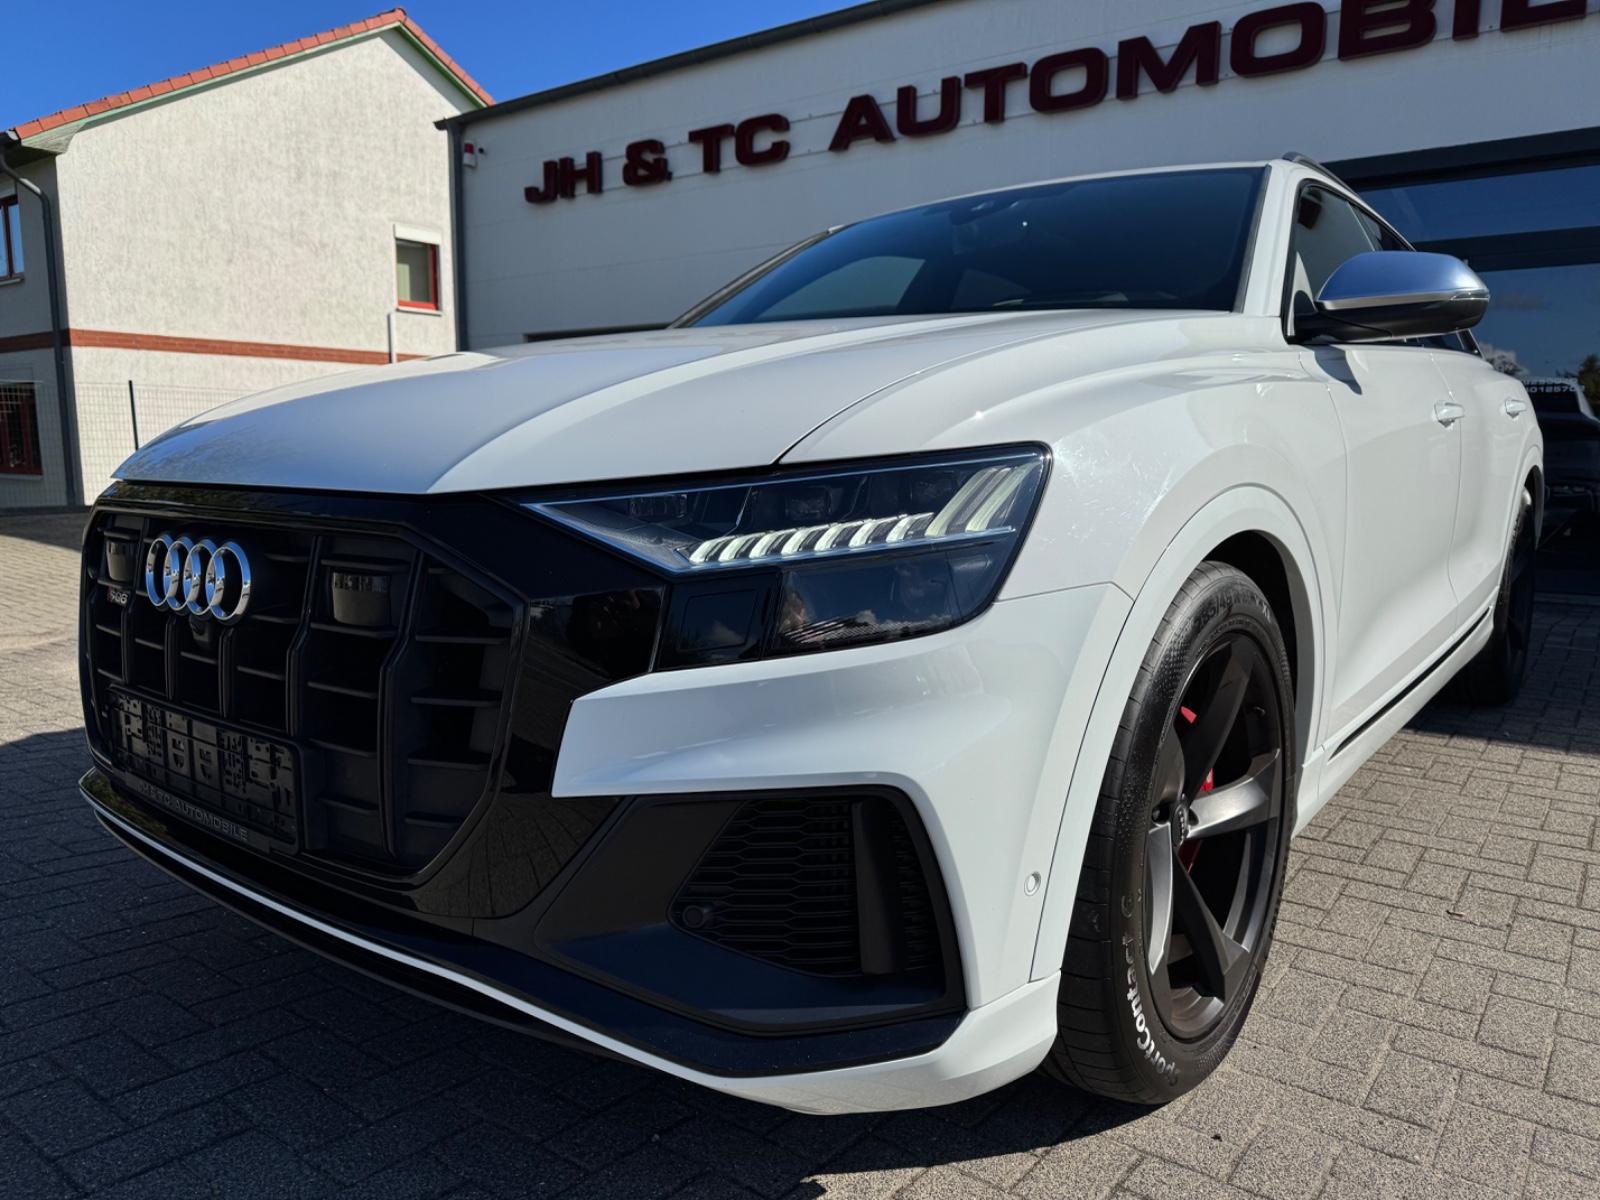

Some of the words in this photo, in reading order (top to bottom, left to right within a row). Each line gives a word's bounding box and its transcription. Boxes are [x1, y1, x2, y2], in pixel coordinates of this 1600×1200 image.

[524, 151, 603, 204] JH
[622, 139, 672, 187] &
[689, 113, 790, 173] TC
